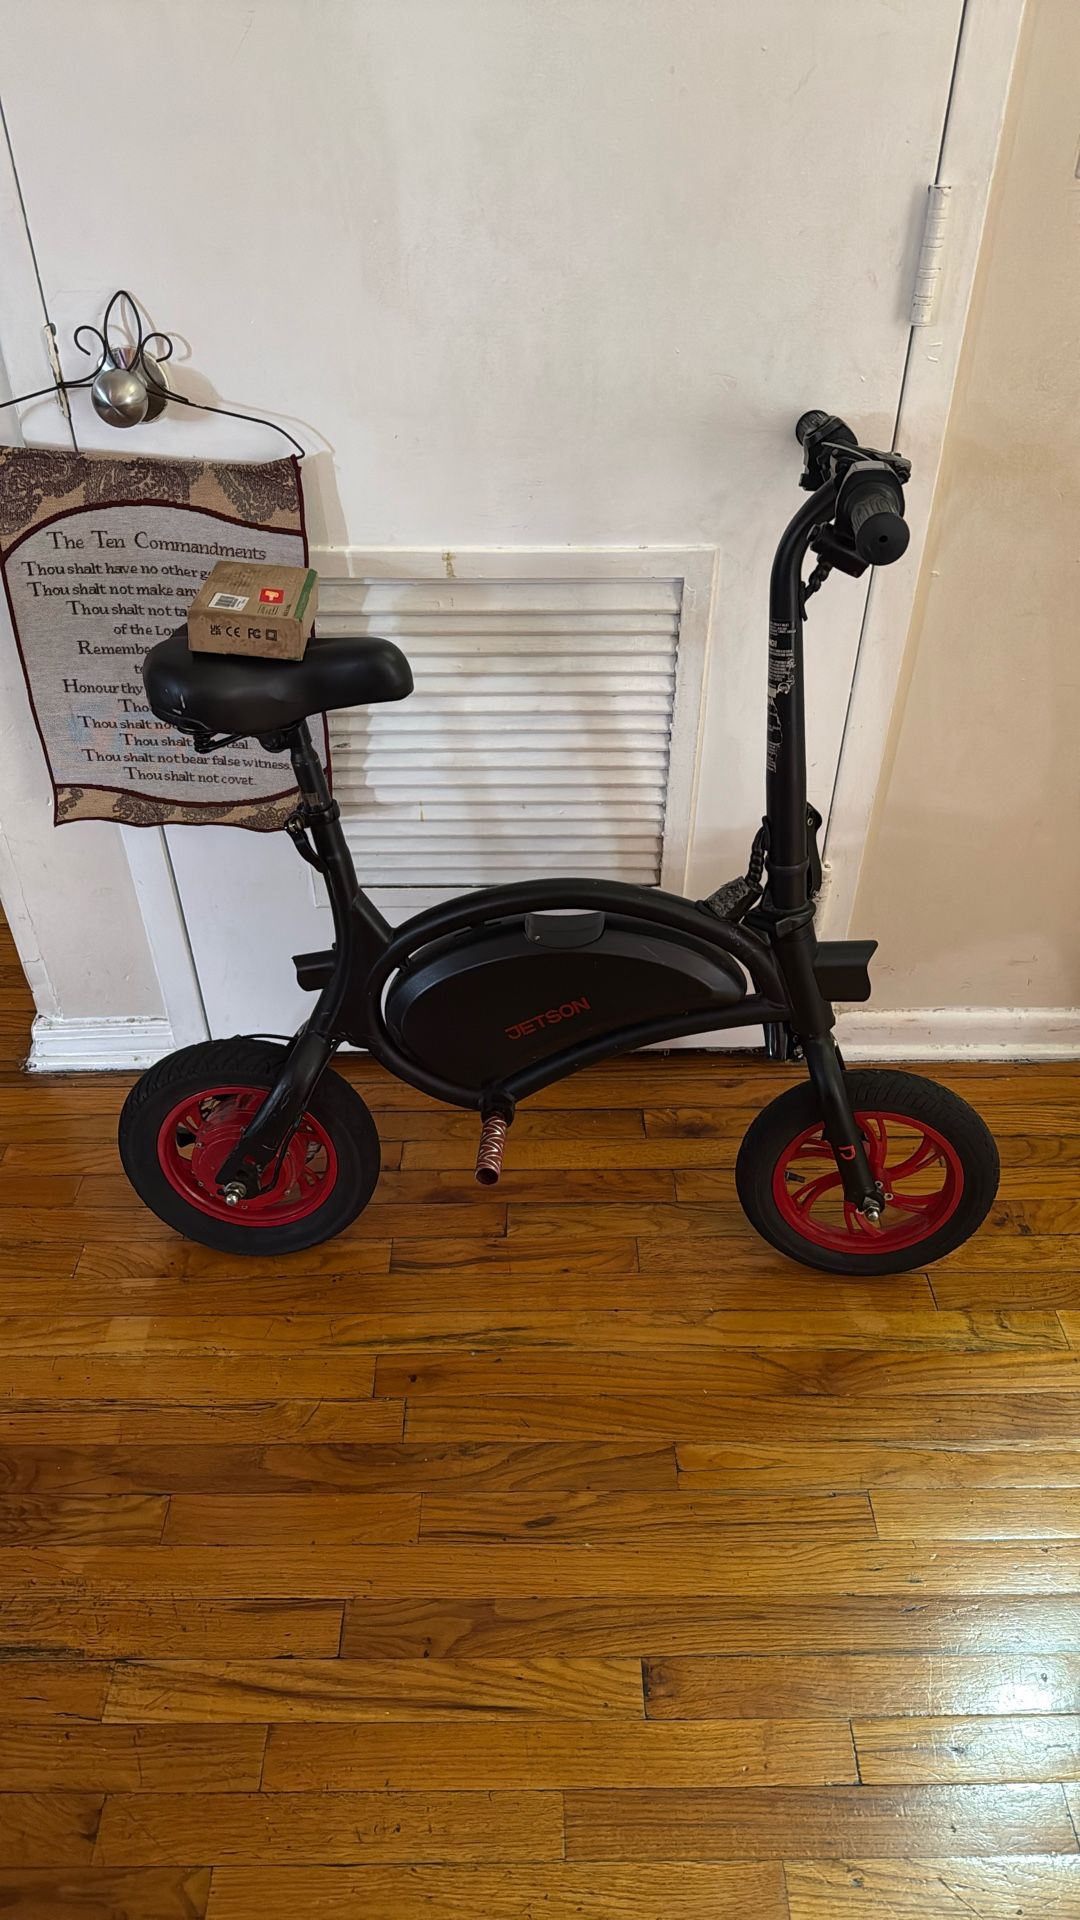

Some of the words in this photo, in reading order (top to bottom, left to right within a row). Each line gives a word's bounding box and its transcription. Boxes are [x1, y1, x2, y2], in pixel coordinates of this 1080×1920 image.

[46, 531, 85, 550] The
[90, 530, 126, 549] Ten
[134, 531, 267, 560] Commandments
[21, 561, 66, 577] Thou
[67, 562, 102, 575] shalt
[104, 563, 138, 575] have
[140, 565, 159, 575] no
[161, 565, 199, 578] other
[26, 581, 70, 597] Thou
[72, 583, 107, 595] shalt
[109, 584, 135, 595] not
[136, 584, 173, 596] make
[65, 600, 110, 616] Thou
[111, 603, 145, 616] shalt
[147, 606, 174, 617] not
[113, 623, 128, 635] of
[129, 624, 153, 636] the
[77, 640, 153, 655] Remembe
[61, 678, 120, 694] Honour
[121, 683, 144, 696] thy
[117, 698, 152, 713] Tho
[77, 715, 118, 729] Thou
[119, 719, 152, 730] shalt
[119, 732, 158, 747] Thou
[161, 736, 193, 747] shalt
[81, 748, 121, 762] Thou
[123, 753, 155, 763] shalt
[157, 754, 180, 764] not
[181, 754, 209, 765] bear
[211, 755, 240, 767] false
[242, 758, 293, 770] witness.
[122, 766, 162, 781] Thou
[163, 770, 195, 782] shalt
[197, 774, 220, 784] not
[221, 775, 257, 786] covet.
[504, 996, 591, 1040] JETSON
